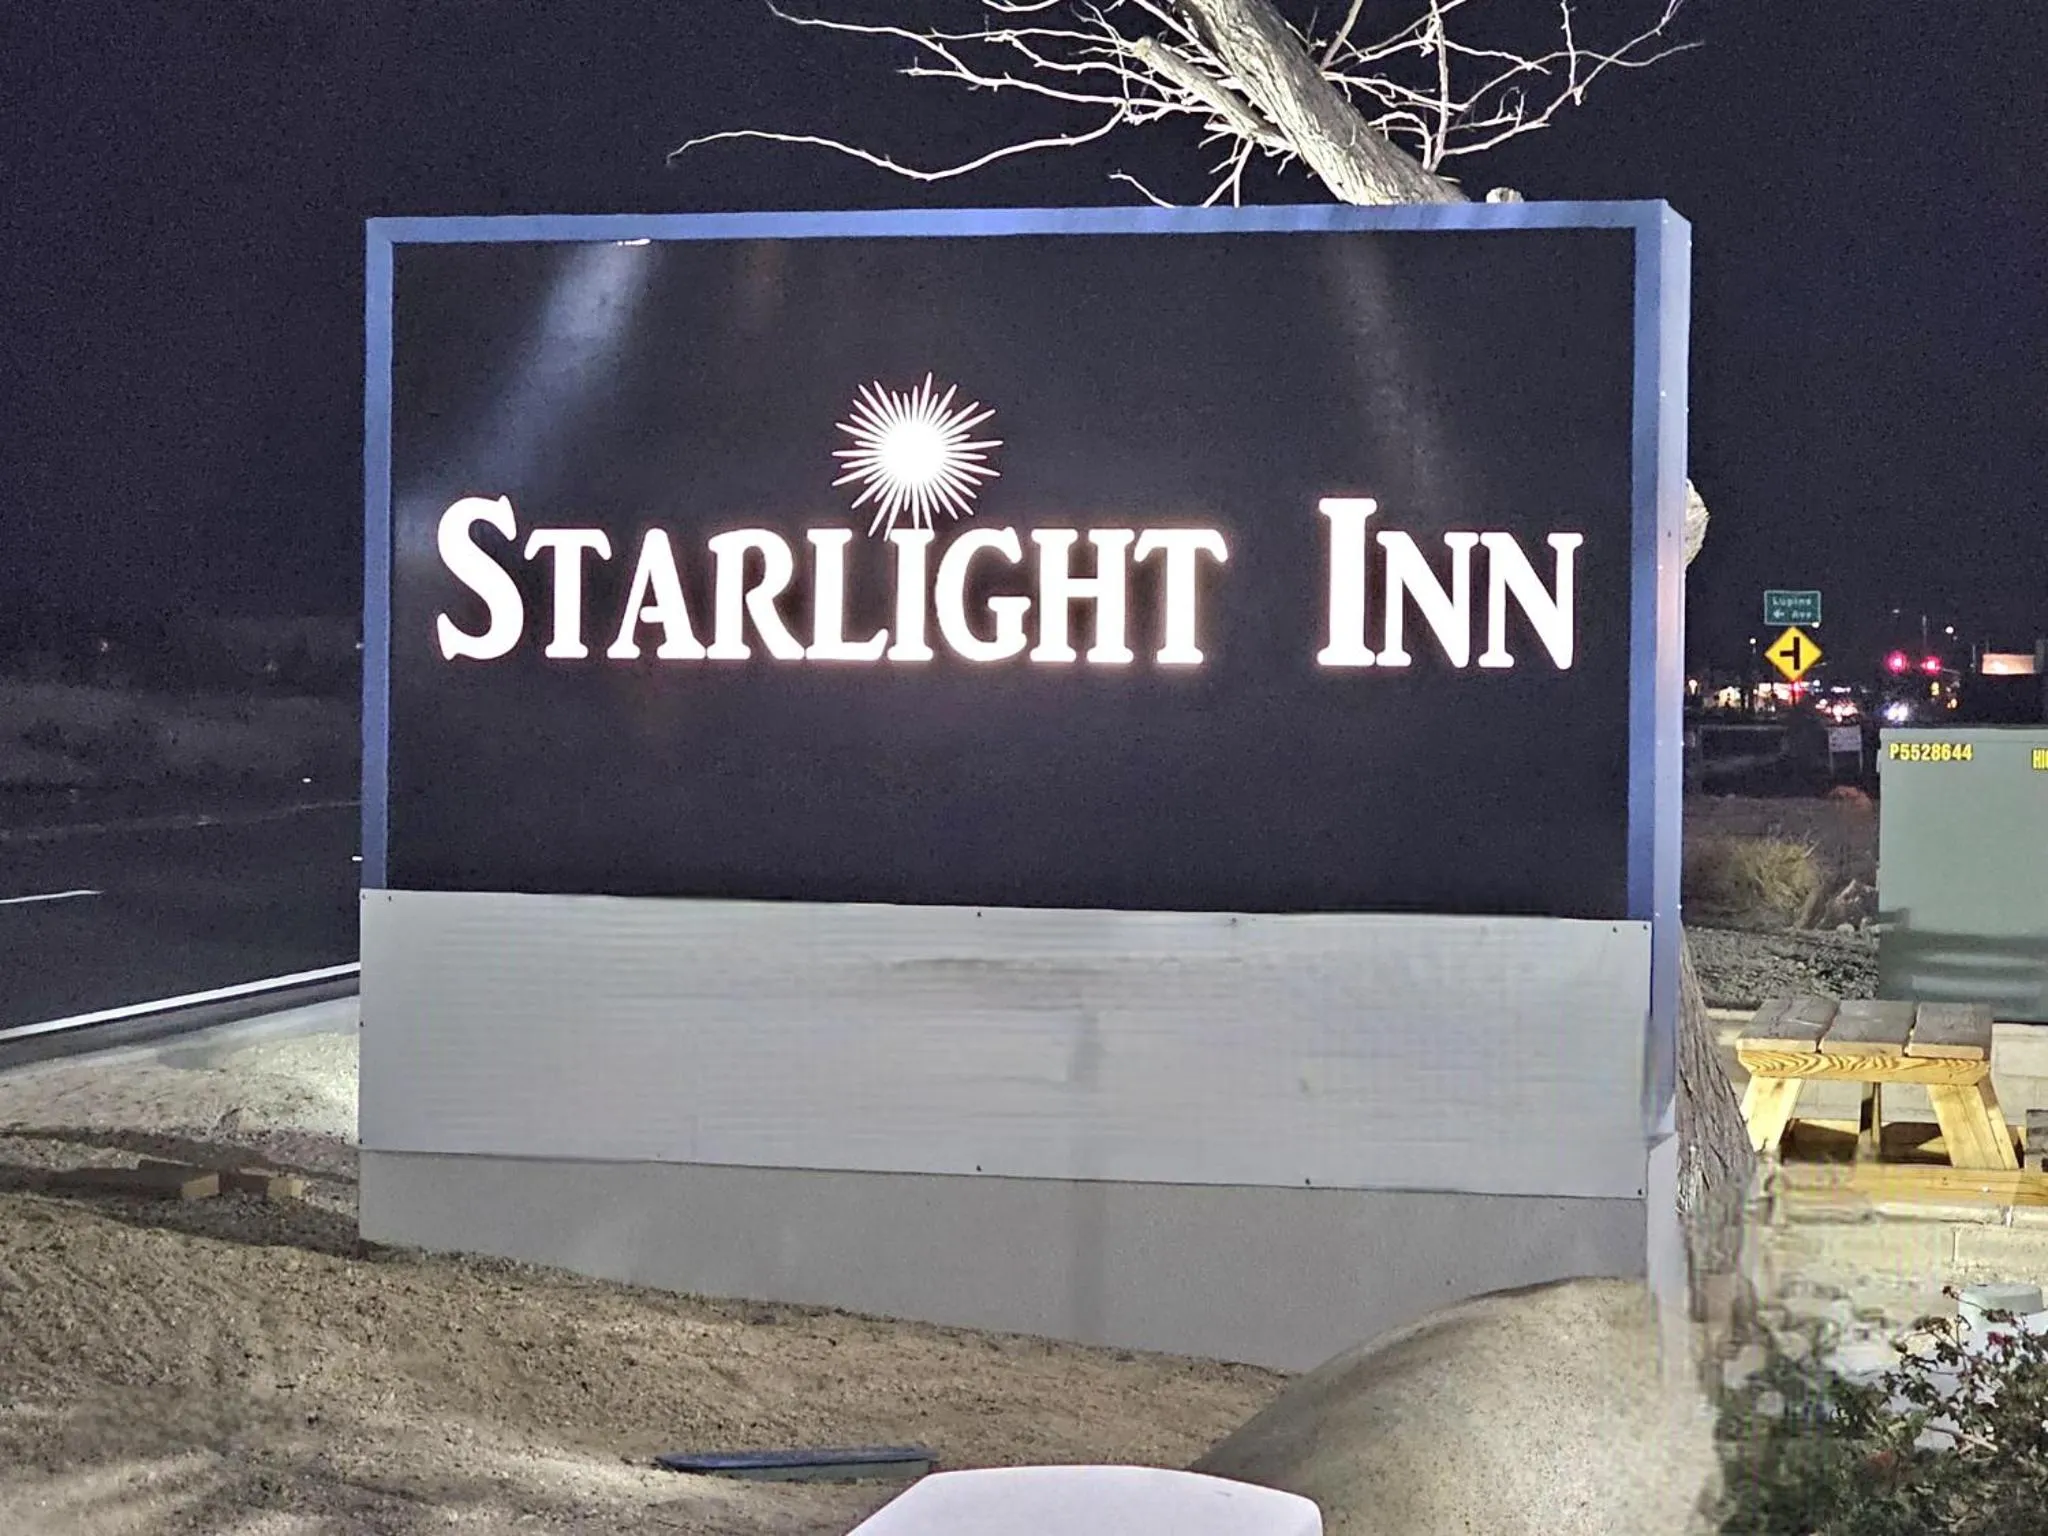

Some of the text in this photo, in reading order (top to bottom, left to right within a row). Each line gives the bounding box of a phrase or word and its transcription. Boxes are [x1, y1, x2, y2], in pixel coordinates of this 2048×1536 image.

[436, 495, 1584, 669] STARLIGHT INN
[1889, 743, 1973, 761] P5528644
